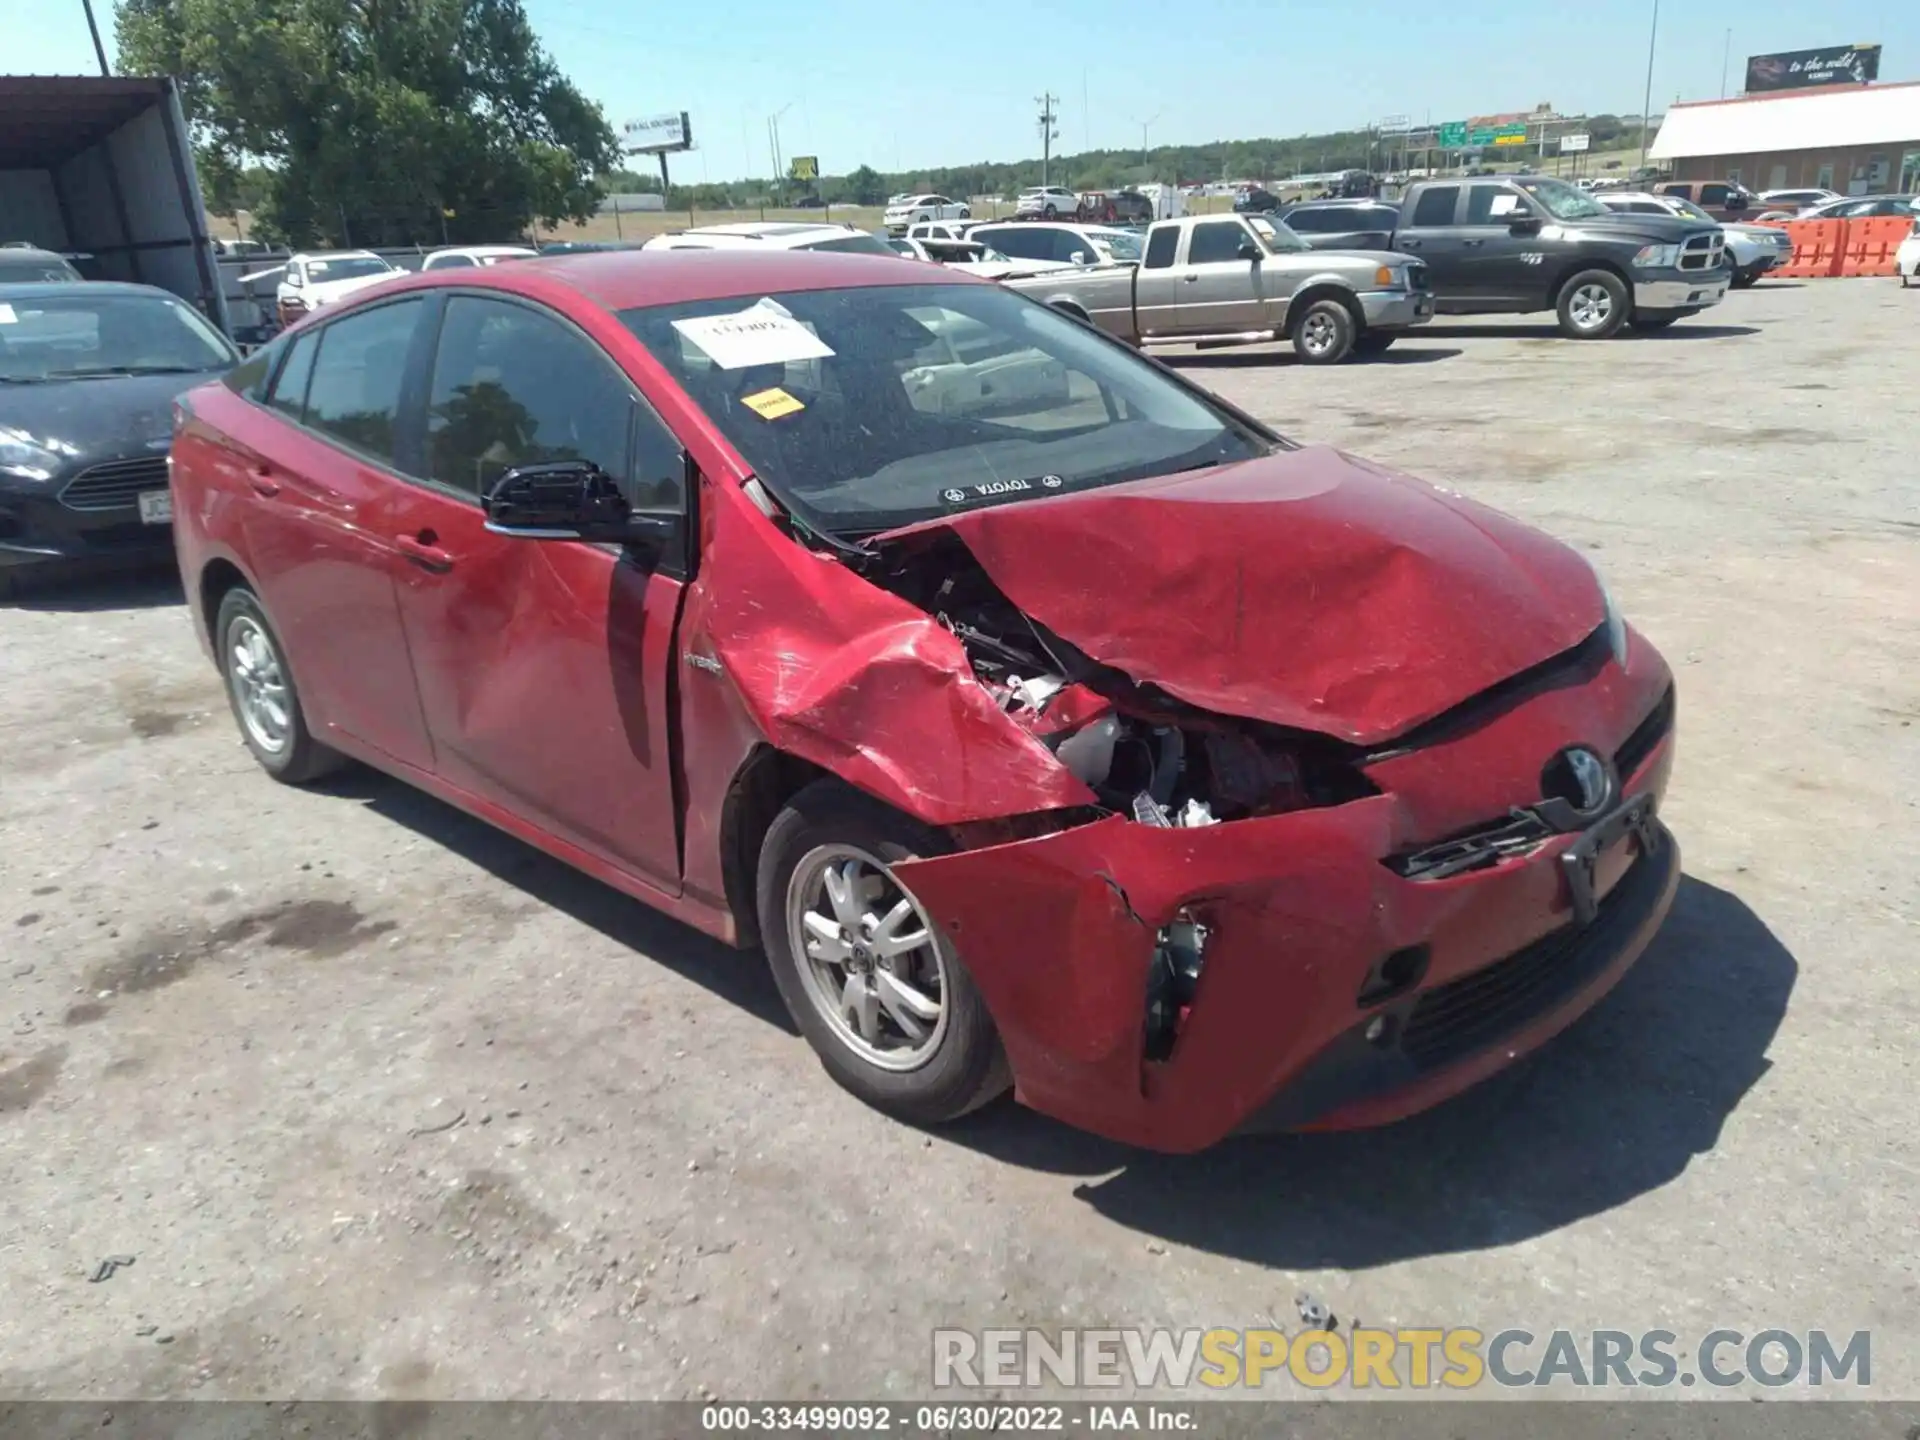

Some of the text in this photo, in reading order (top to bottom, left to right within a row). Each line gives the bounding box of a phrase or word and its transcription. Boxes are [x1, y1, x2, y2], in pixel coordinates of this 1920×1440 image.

[1790, 52, 1856, 72] to the wild
[975, 479, 1032, 495] TOYOTA
